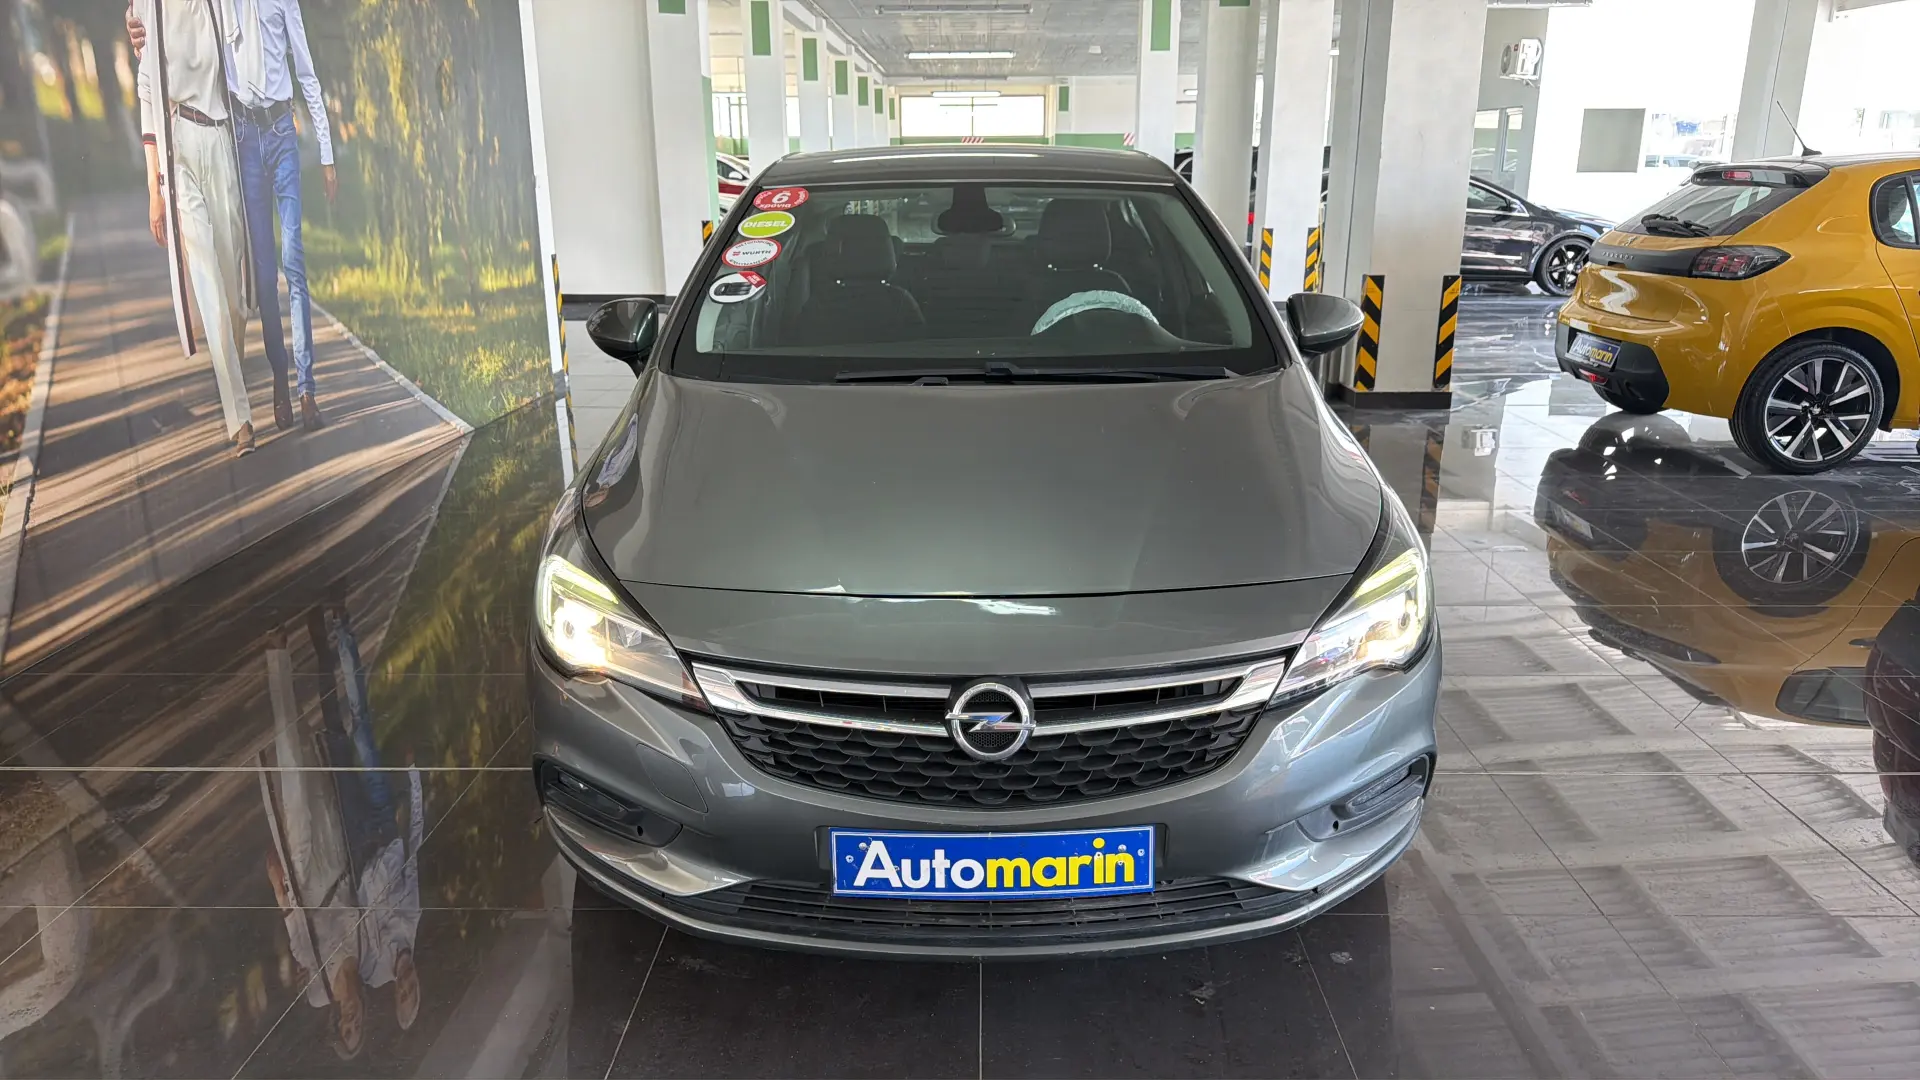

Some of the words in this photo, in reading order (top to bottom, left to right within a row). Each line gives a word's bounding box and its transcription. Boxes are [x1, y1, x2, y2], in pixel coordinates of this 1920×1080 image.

[772, 192, 791, 204] 6
[1572, 337, 1613, 363] Automarin
[853, 837, 1134, 889] Automarin
